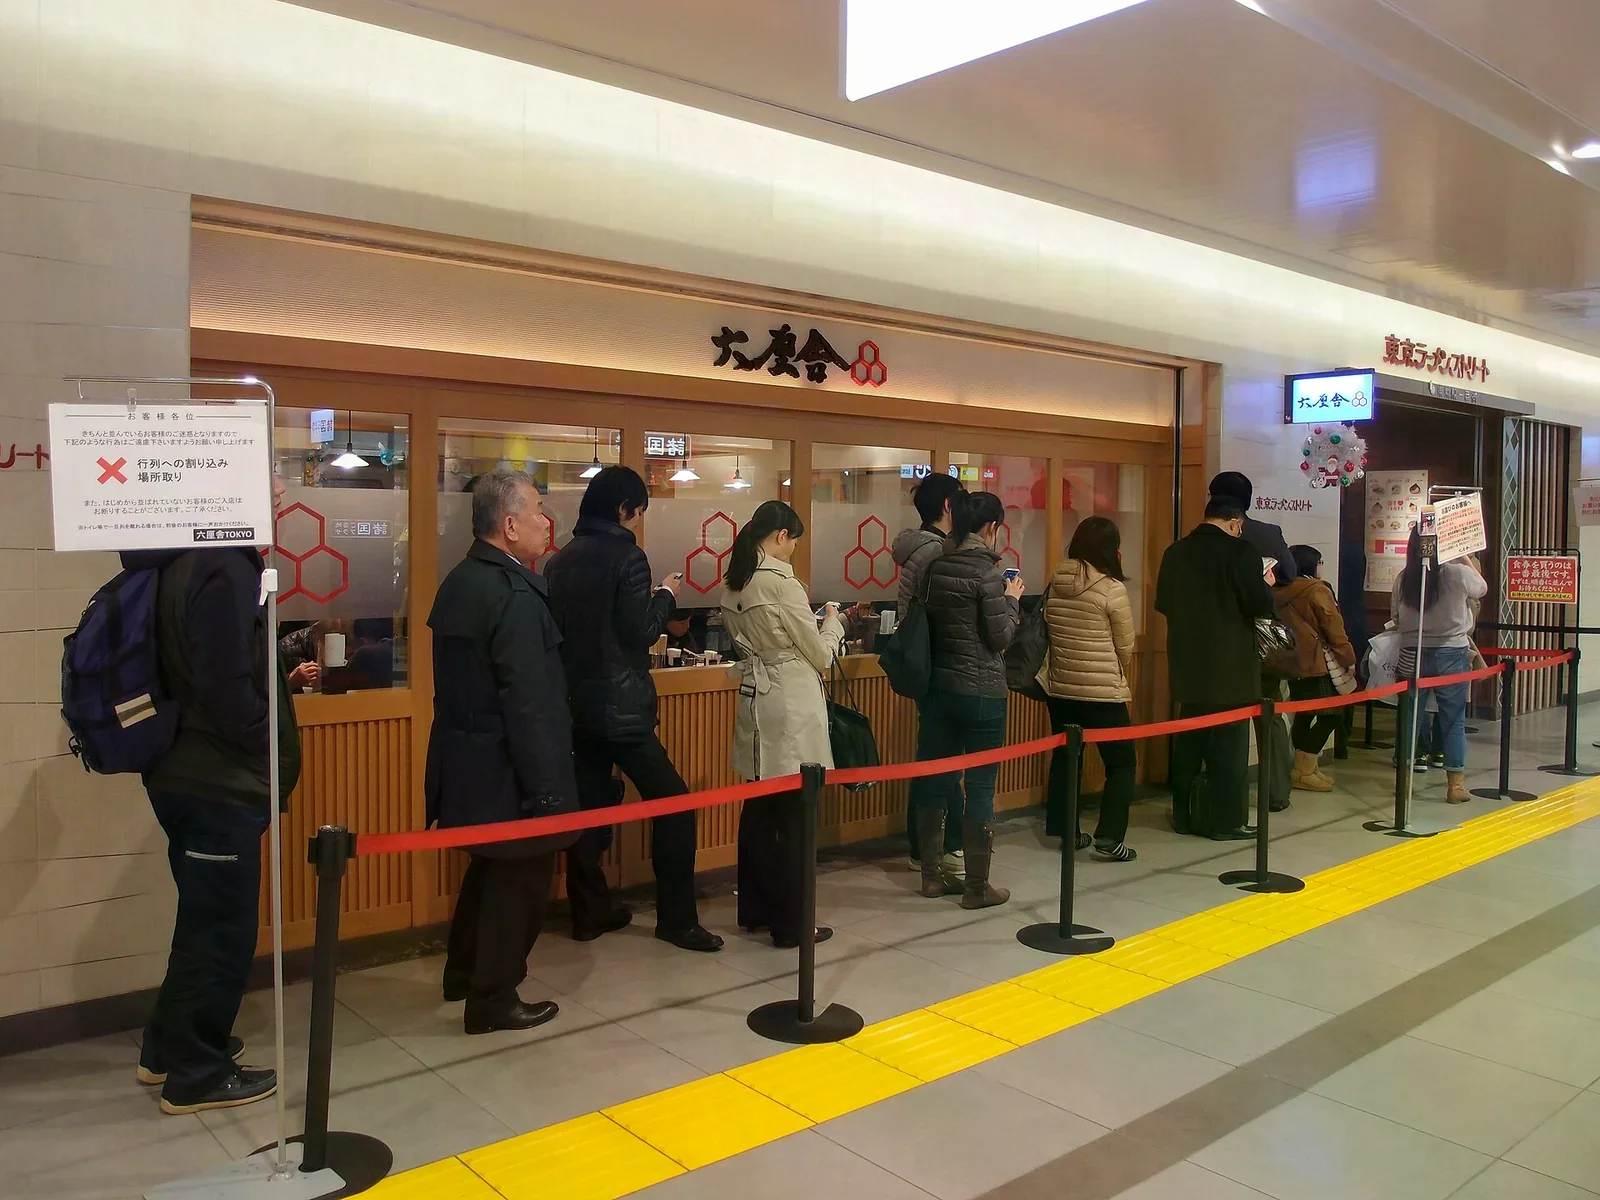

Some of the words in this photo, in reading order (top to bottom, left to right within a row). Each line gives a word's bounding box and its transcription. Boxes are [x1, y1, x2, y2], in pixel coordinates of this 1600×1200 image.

[1383, 333, 1490, 383] 東京ラーメンストリート
[1297, 392, 1350, 409] 六厘舎
[127, 412, 195, 421] お客様各位
[81, 430, 238, 438] きちんと並んでいるお客様のご迷惑となりますので
[64, 438, 255, 446] 下記のような行為はご遠慮下さいますようお願い申し上げます
[137, 458, 229, 469] 行列への割り込み
[137, 471, 183, 483] 場所取り
[83, 497, 243, 507] また、はじめから並ばれていないお客様のご入店は
[1255, 496, 1312, 511] 東京ラーメンストリート
[93, 506, 233, 515] お断りすることがございます。ご了承ください。
[1513, 560, 1572, 569] 食券を買うのは
[1511, 569, 1571, 579] 一番最後です。
